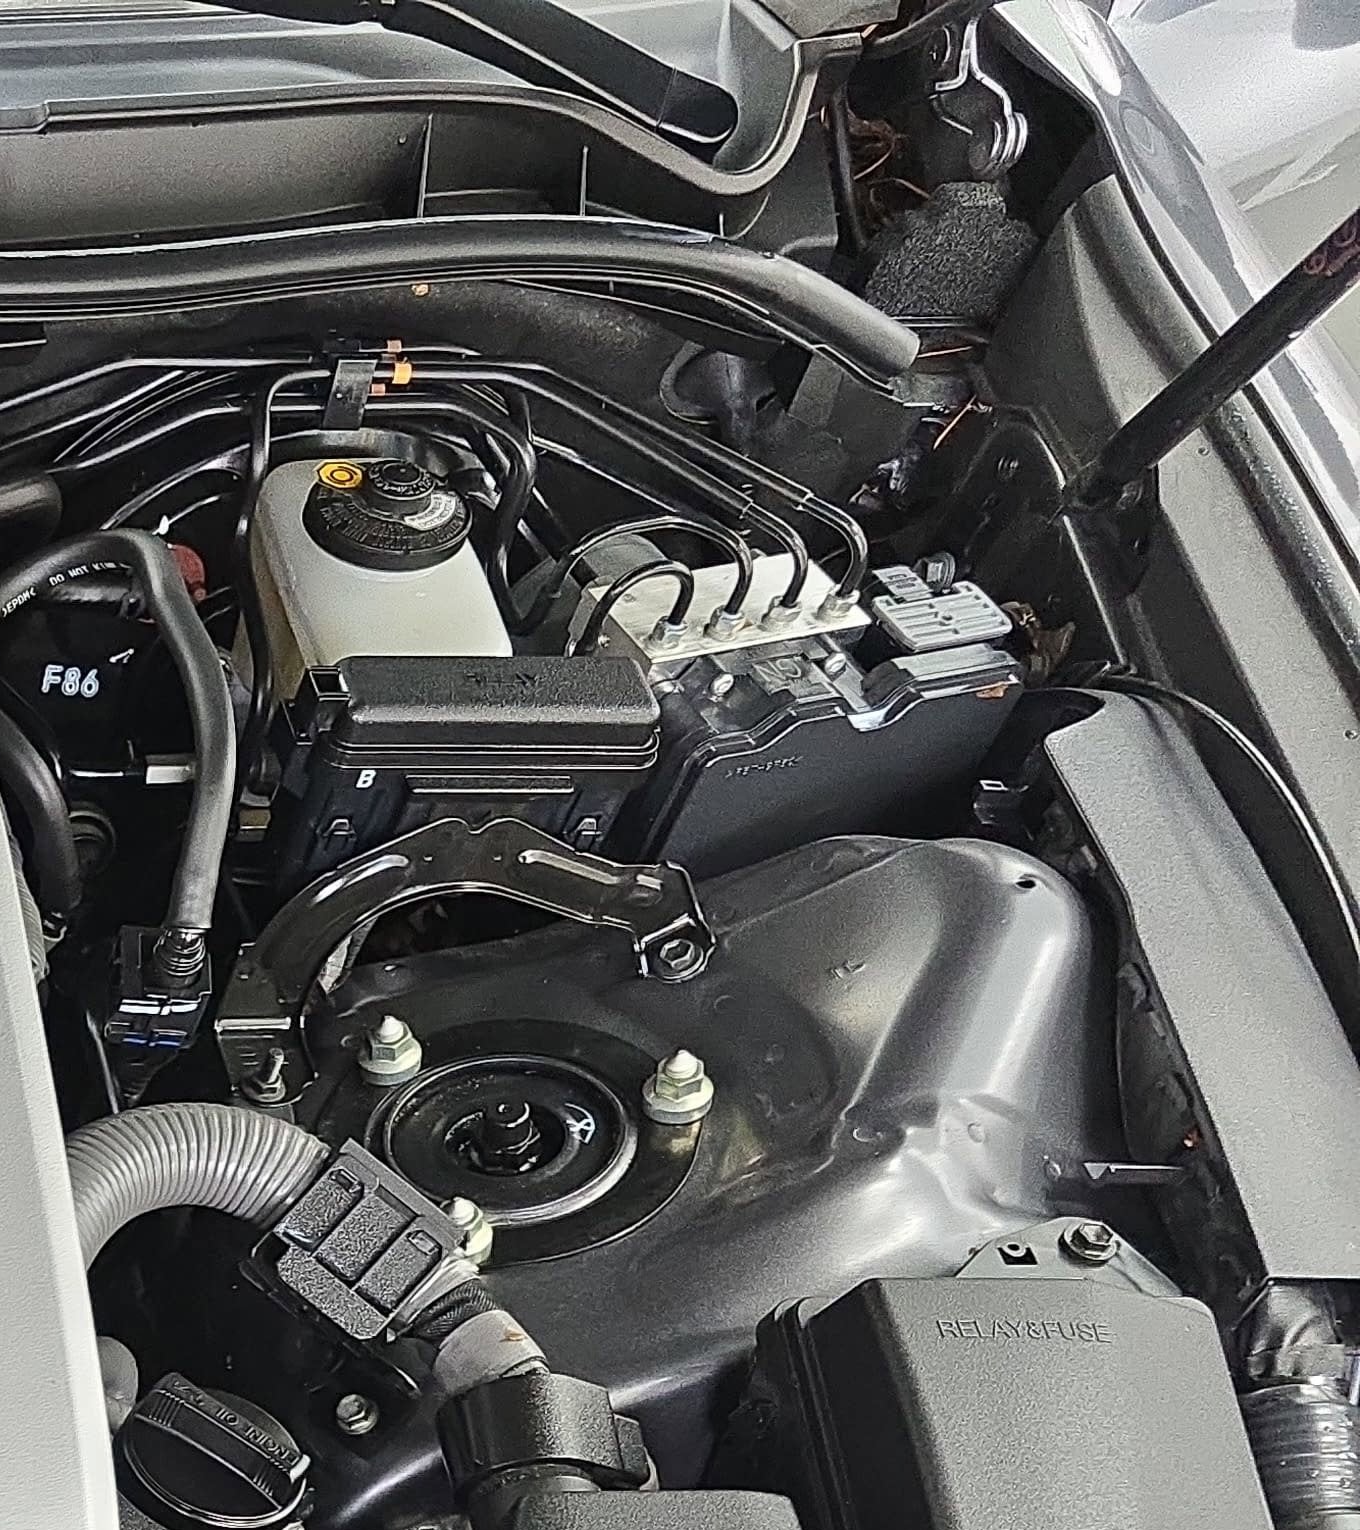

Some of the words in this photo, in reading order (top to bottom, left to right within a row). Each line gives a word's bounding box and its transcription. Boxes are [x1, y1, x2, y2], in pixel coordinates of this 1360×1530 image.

[48, 573, 65, 587] DO
[41, 664, 99, 698] F86
[355, 768, 377, 789] B
[935, 1318, 1113, 1344] RELAY&FUSE
